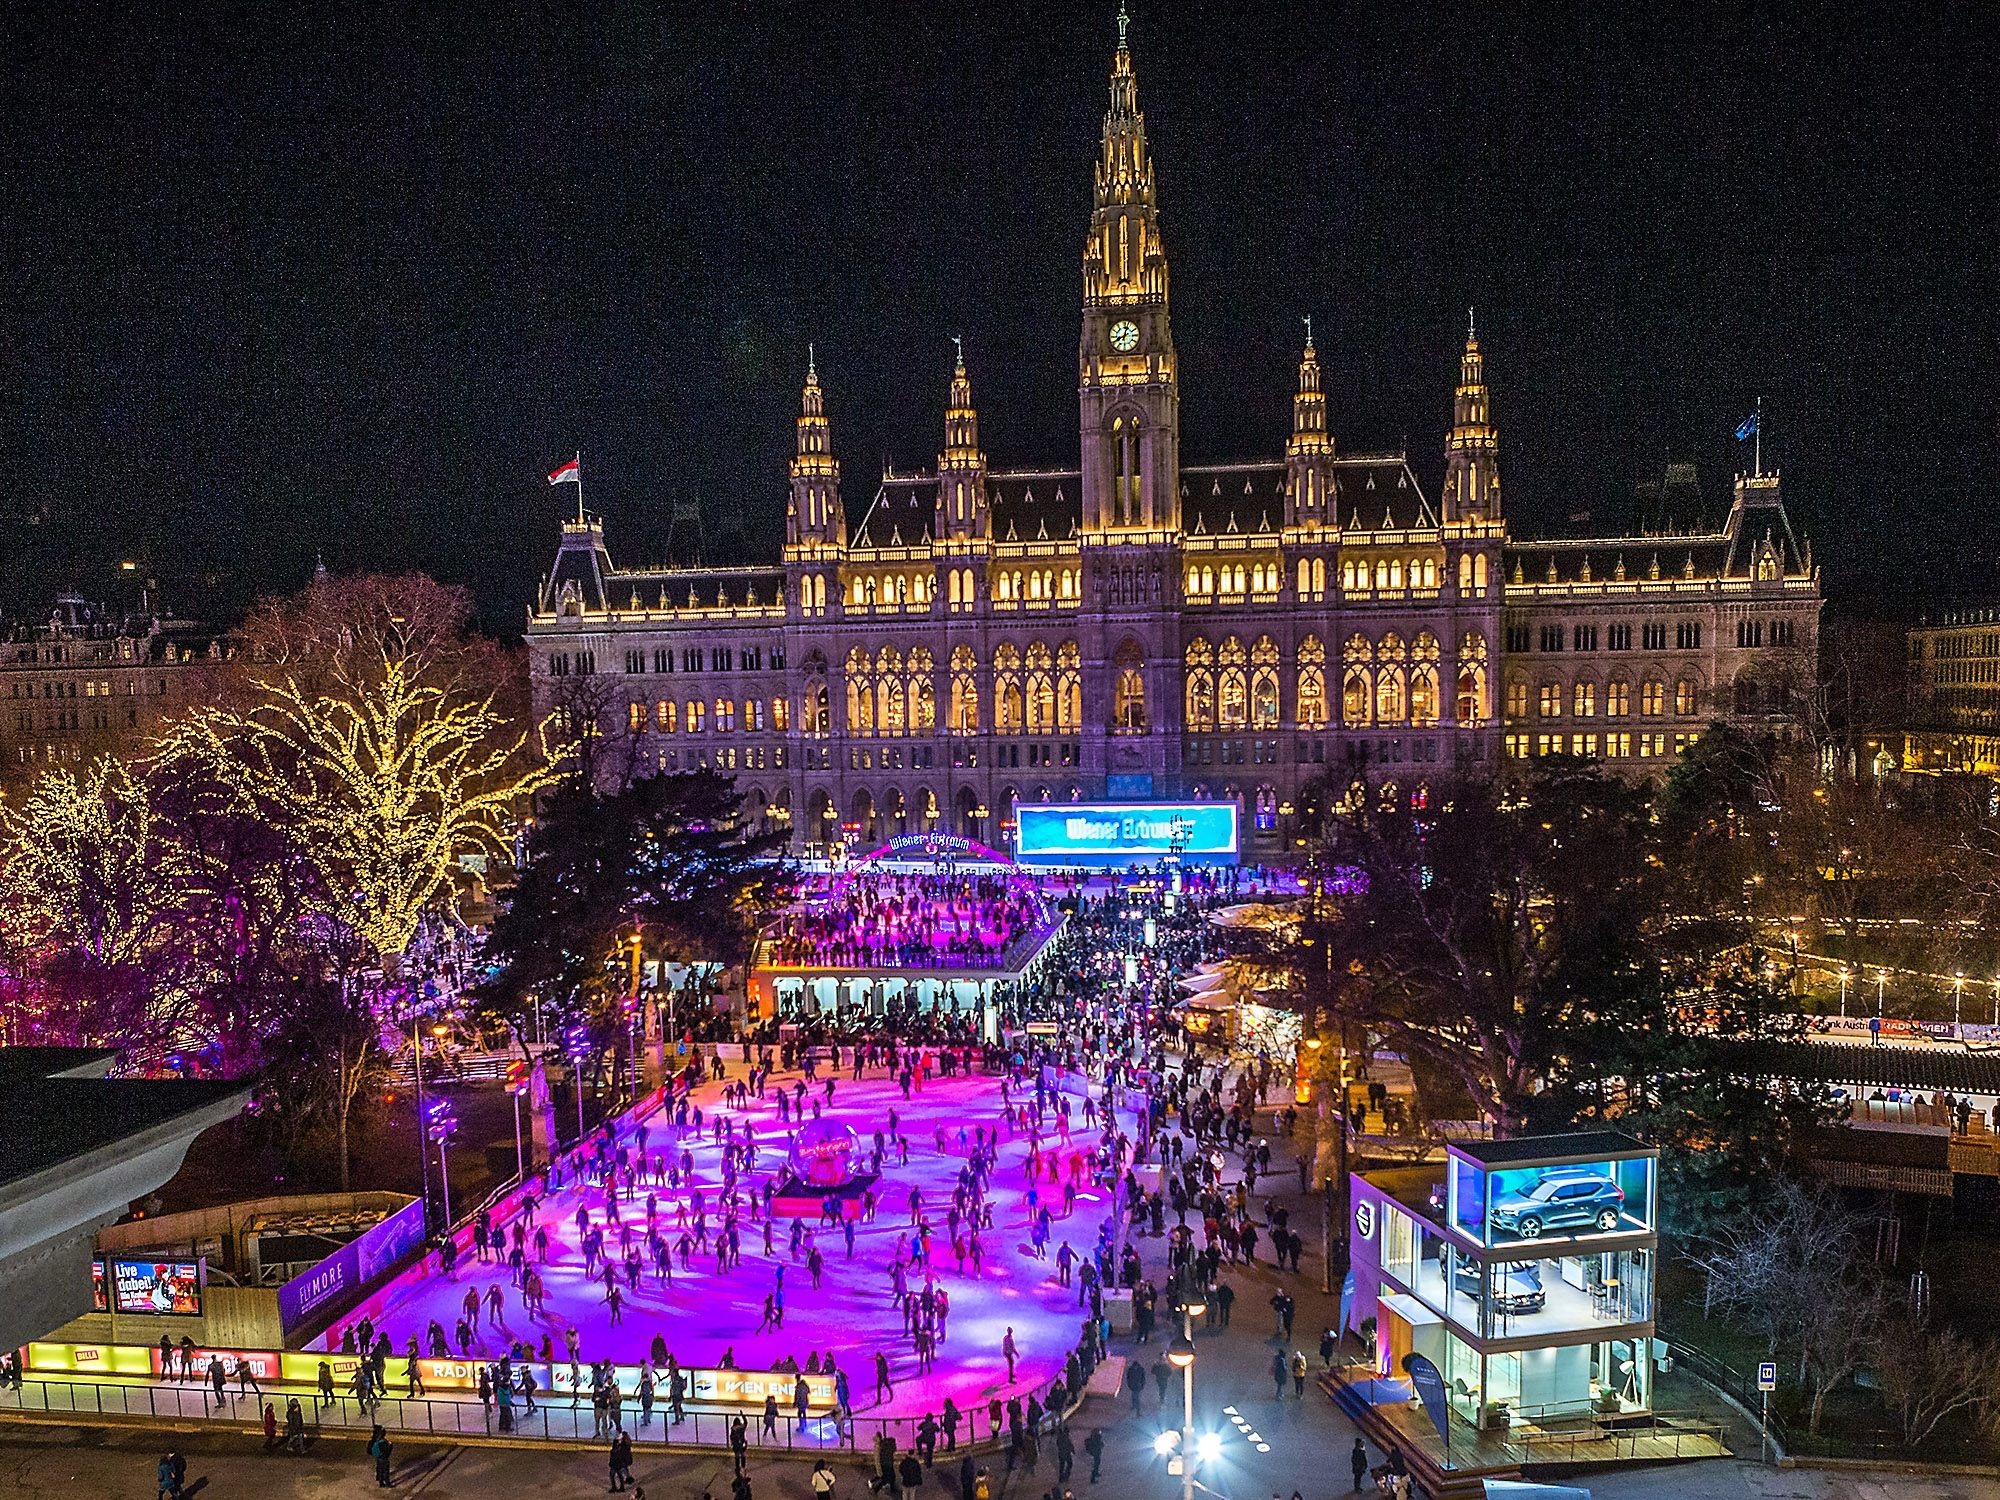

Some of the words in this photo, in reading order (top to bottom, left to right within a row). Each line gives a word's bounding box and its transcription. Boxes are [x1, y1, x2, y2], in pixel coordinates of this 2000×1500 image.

[1066, 817, 1119, 840] Wiener
[889, 834, 927, 850] Wiener
[930, 832, 970, 850] Eistraum
[1843, 1020, 1869, 1031] Austri
[1884, 1021, 1913, 1031] RADI
[1919, 1022, 1949, 1033] WIEN
[115, 1263, 138, 1278] Live
[118, 1275, 152, 1292] dabei!
[76, 1351, 98, 1361] BILLA
[334, 1362, 357, 1372] BILLA
[725, 1380, 765, 1394] WIEN
[768, 1383, 832, 1398] ENEGIE
[1222, 1405, 1271, 1453] VOLVO
